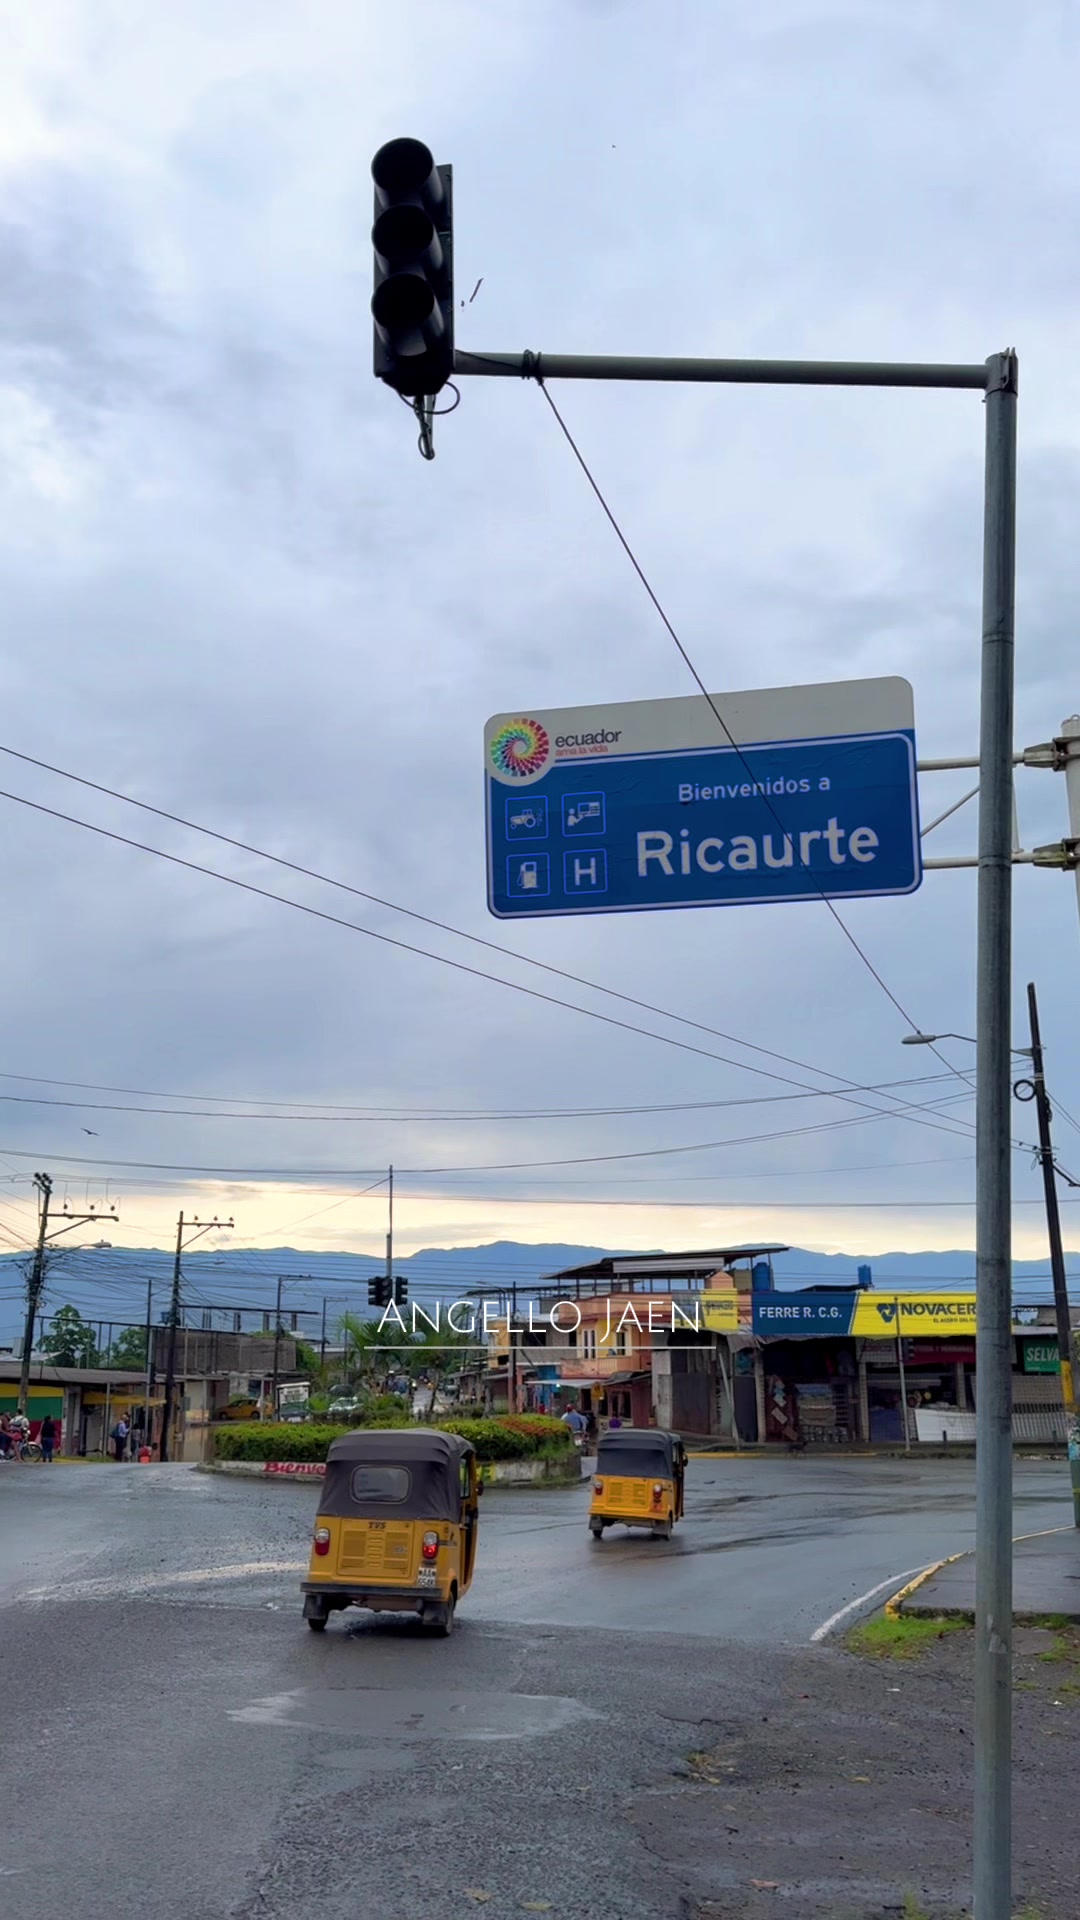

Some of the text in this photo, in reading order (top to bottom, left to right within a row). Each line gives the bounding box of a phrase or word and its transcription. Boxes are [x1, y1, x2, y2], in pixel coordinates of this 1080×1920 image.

[555, 728, 622, 748] ecuador
[555, 744, 608, 757] ama la vida
[678, 776, 831, 802] Bienvenidos a
[636, 816, 879, 877] Ricaurte
[574, 857, 596, 886] H
[759, 1306, 842, 1319] FERRE R. C.G.
[901, 1303, 976, 1316] NOVACER
[1026, 1346, 1060, 1361] SELVA
[263, 1460, 328, 1475] Bienve
